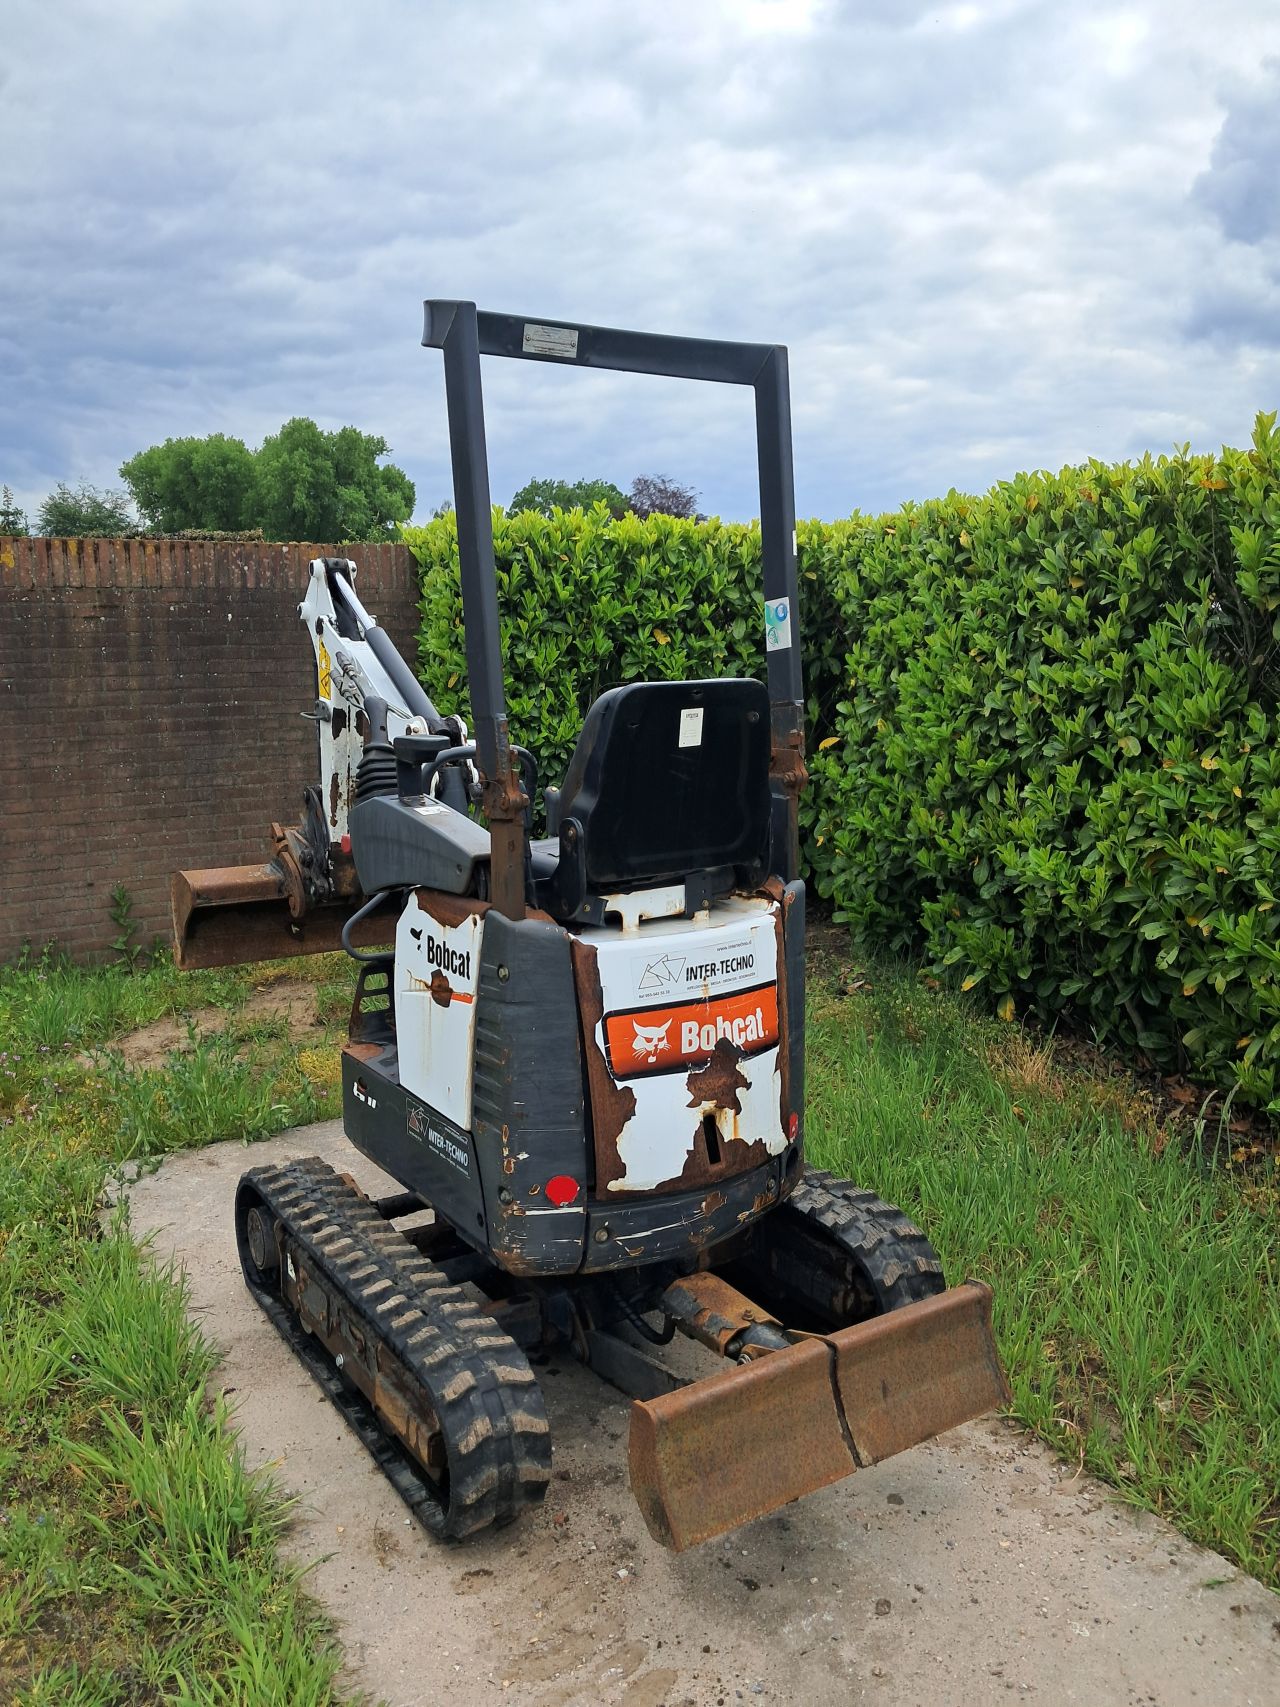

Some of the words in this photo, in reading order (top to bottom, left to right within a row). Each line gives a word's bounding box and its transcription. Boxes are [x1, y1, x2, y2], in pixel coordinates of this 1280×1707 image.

[427, 934, 471, 981] Bobcat
[685, 953, 754, 982] INTER-TECHNO
[681, 1007, 765, 1054] Bobcat
[428, 1127, 469, 1167] INTER-TECHNO
